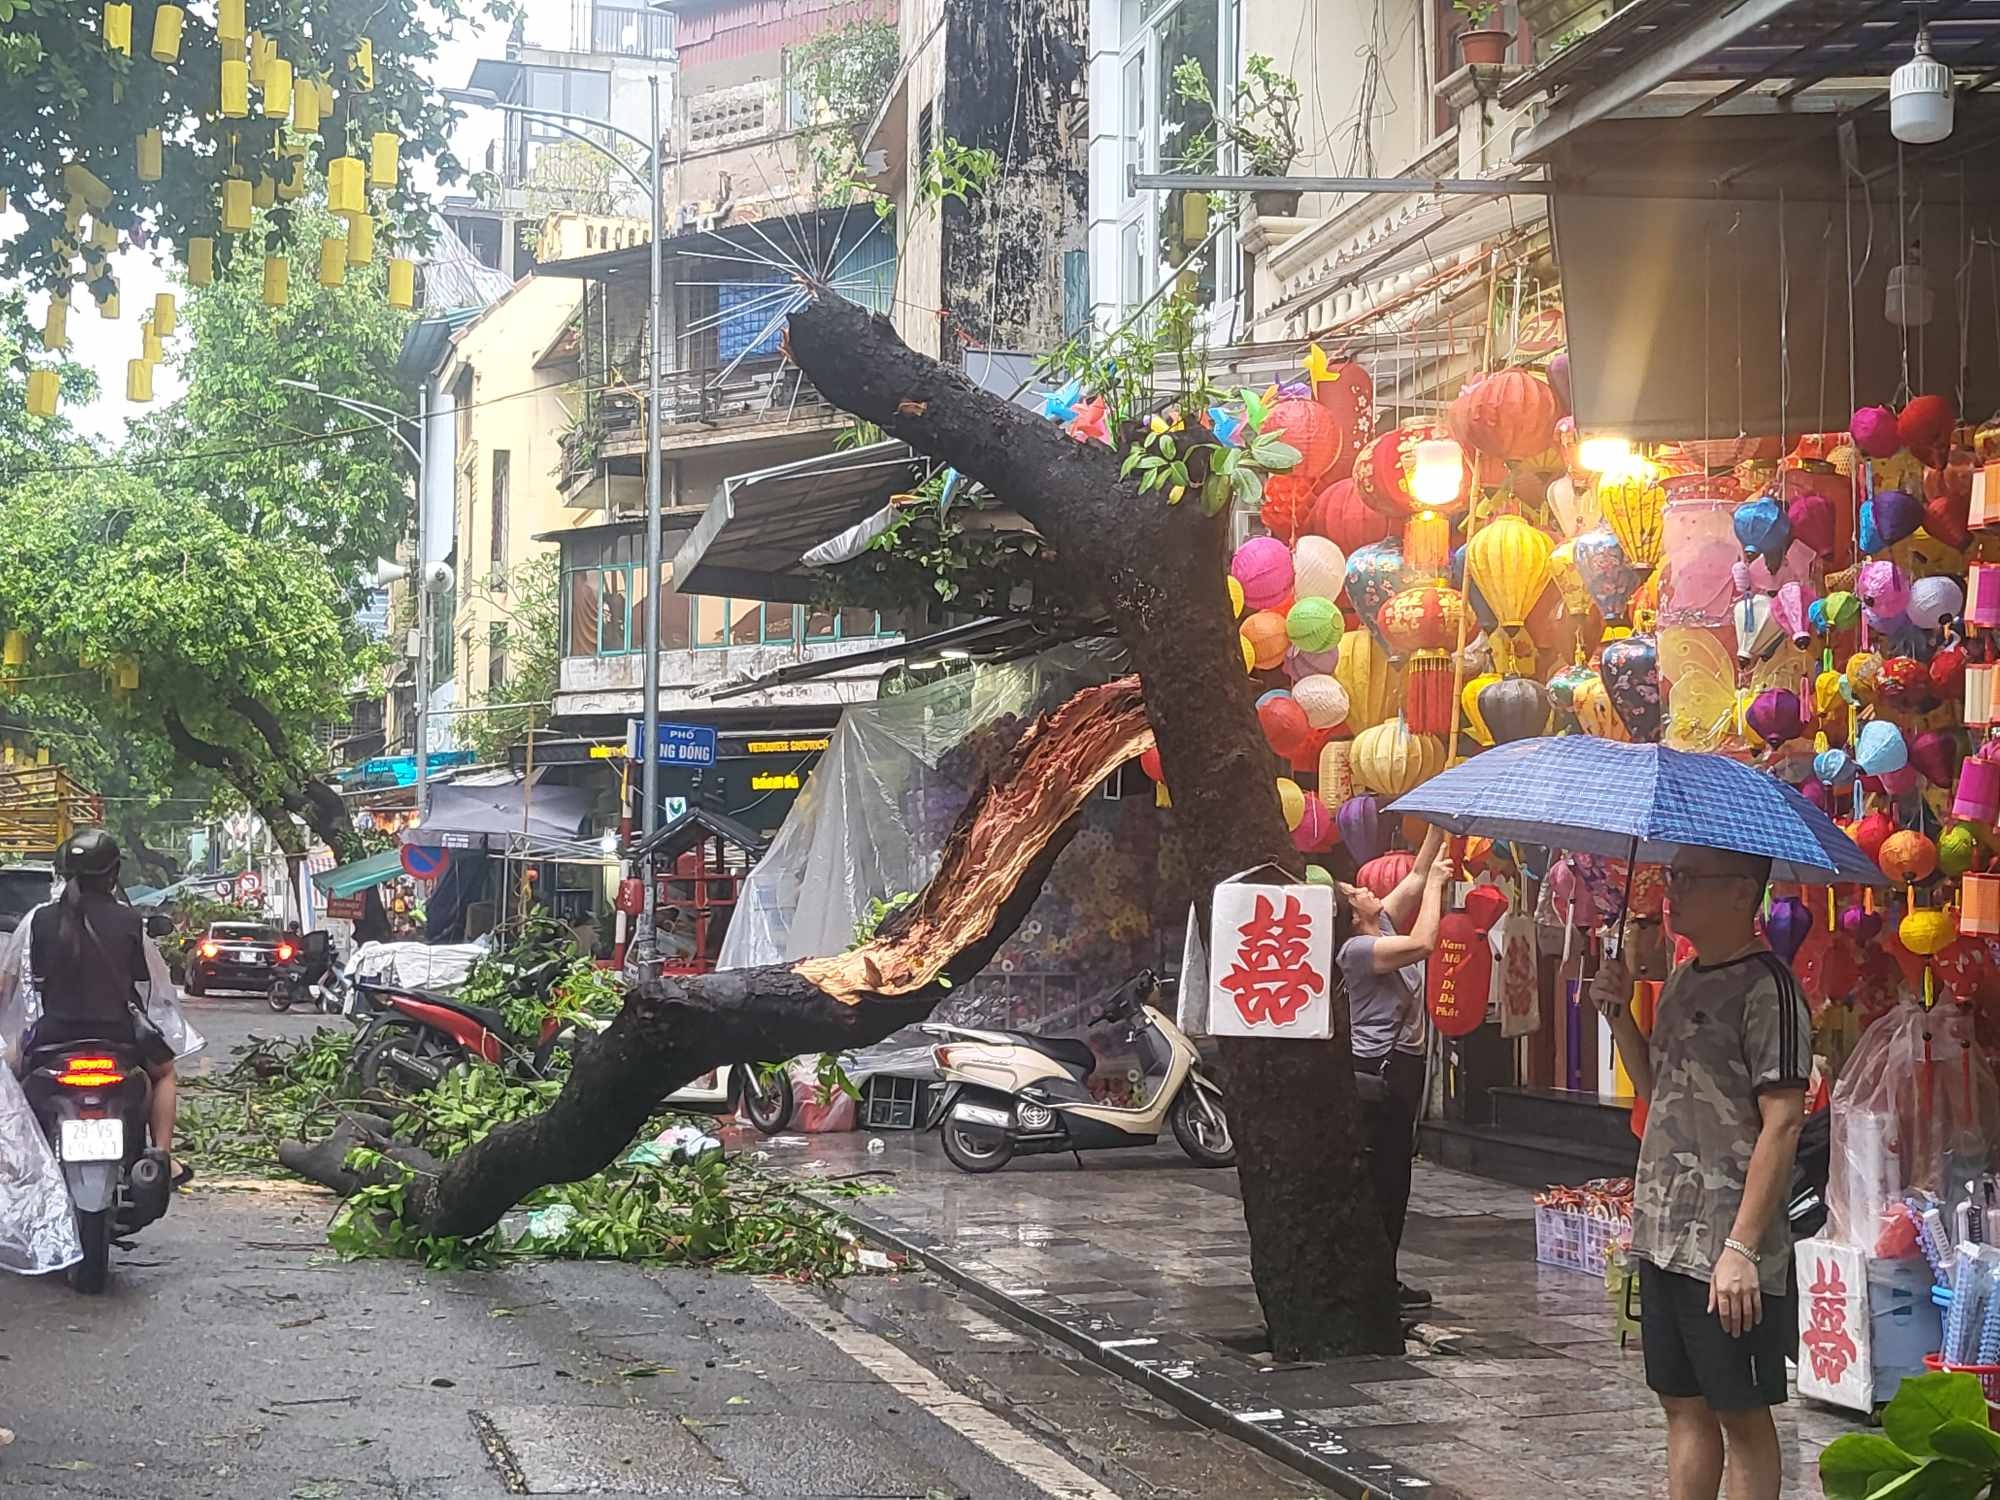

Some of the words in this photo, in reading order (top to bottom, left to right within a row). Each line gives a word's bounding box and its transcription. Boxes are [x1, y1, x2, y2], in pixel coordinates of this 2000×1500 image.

[669, 728, 696, 740] PHỐ
[1440, 939, 1466, 950] Nam
[1441, 953, 1461, 964] Mô
